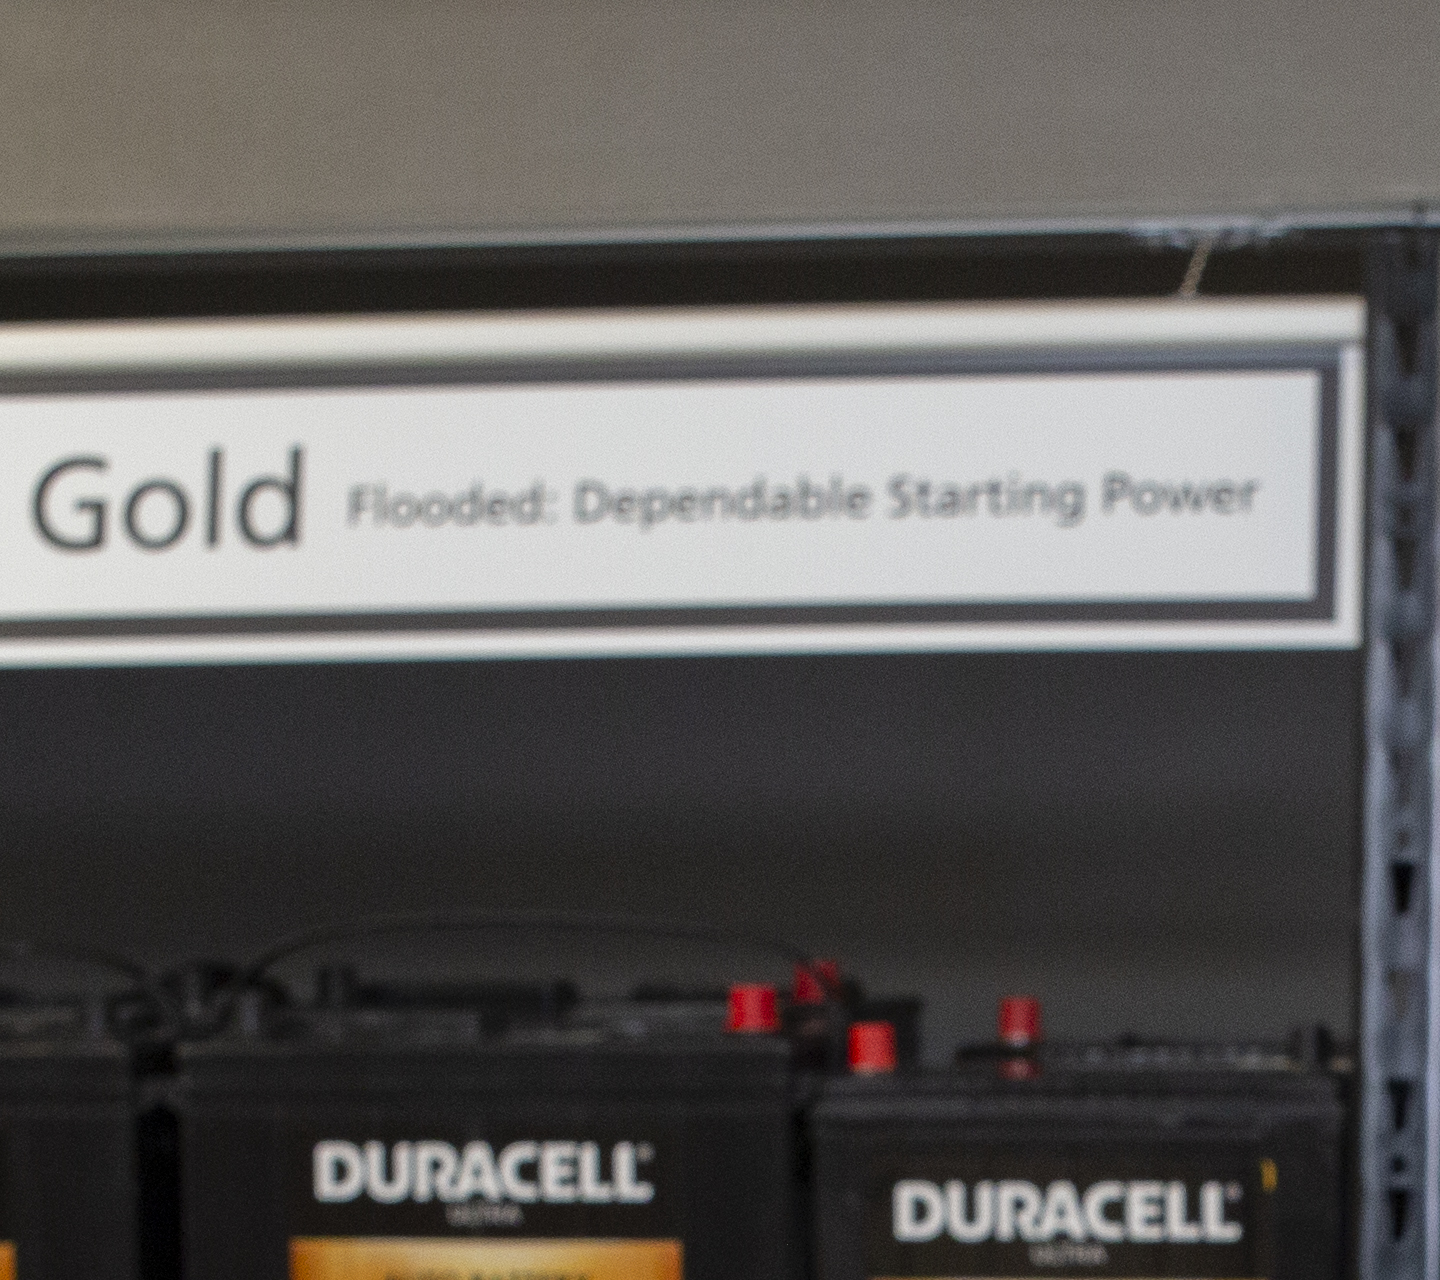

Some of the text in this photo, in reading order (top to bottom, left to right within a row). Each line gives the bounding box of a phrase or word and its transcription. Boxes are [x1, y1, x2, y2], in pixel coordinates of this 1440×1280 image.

[30, 444, 306, 552] Gold
[347, 470, 1262, 531] Flooded: Dependable Starting Power
[313, 1140, 654, 1204] DURACELL
[892, 1179, 1242, 1243] DURACELL
